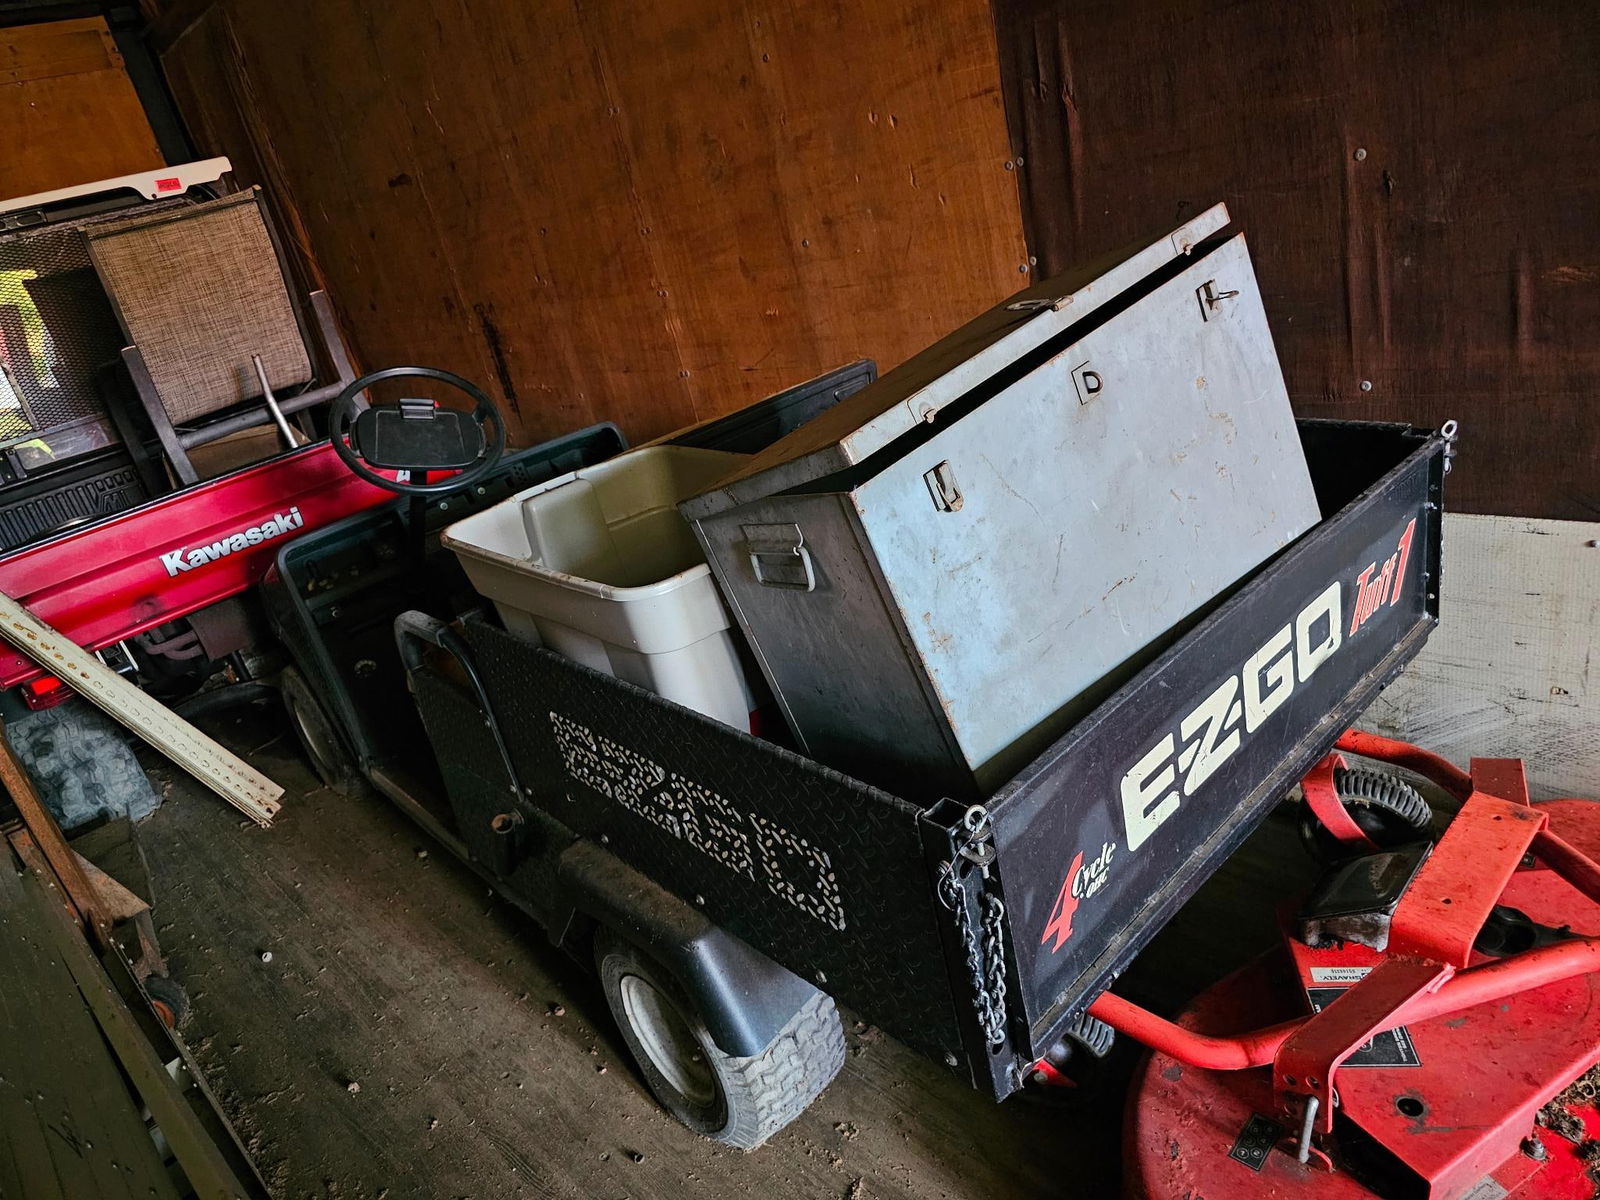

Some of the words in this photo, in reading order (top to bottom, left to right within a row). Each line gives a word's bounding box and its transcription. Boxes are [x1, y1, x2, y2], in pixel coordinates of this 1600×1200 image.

[159, 505, 304, 577] Kawasaki
[1389, 517, 1417, 608] 1
[1041, 849, 1084, 955] 4
[1071, 841, 1117, 898] Cycle
